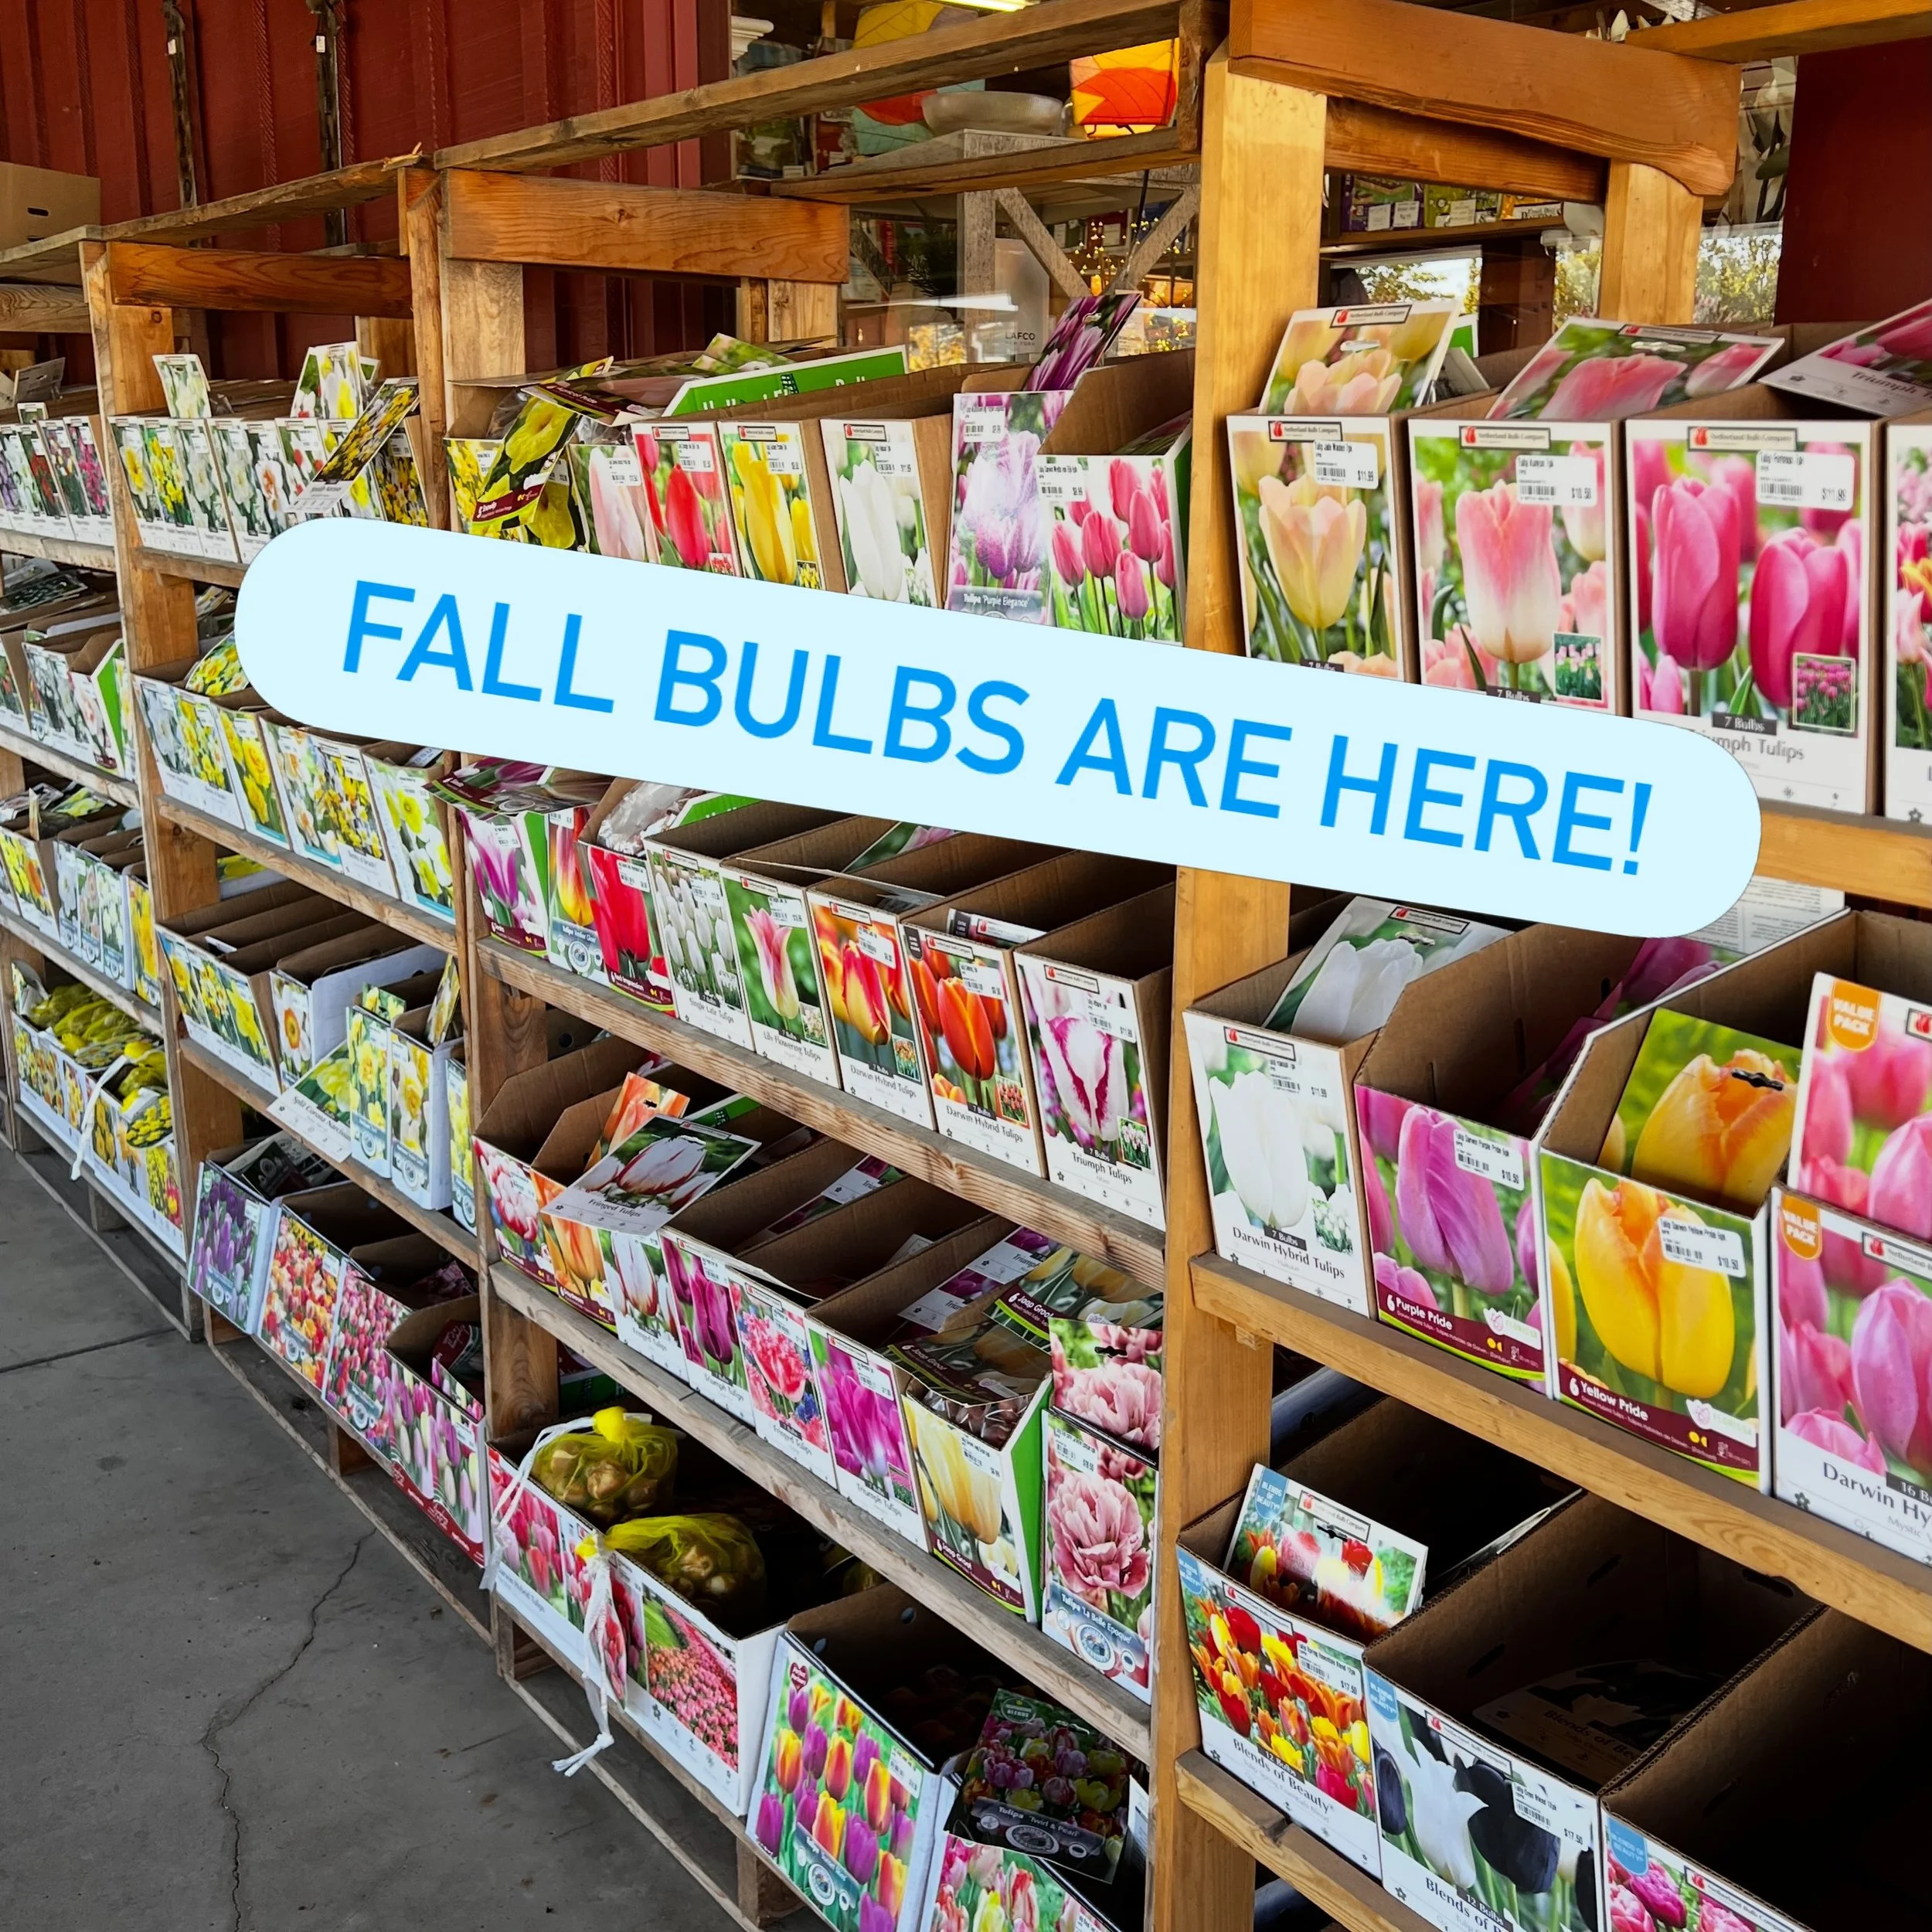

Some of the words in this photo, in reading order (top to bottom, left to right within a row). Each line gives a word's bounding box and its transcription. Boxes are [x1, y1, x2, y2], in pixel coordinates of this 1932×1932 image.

[1005, 332, 1036, 341] LAFCO
[1852, 371, 1917, 393] Triumph
[963, 593, 981, 605] Tulipa
[1724, 716, 1732, 727] 7
[1734, 718, 1764, 732] Bulbs
[1758, 736, 1805, 761] Tulips
[718, 1006, 734, 1025] Tulips
[1833, 998, 1876, 1018] VALUE
[1834, 1013, 1870, 1036] PACK
[774, 1034, 803, 1054] Flowering
[803, 1046, 821, 1062] Tulips
[850, 1063, 873, 1080] Darwin
[875, 1073, 896, 1090] Hybrid
[897, 1081, 917, 1098] Tulips
[292, 1095, 304, 1111] Split
[305, 1103, 325, 1121] Corona
[946, 1106, 973, 1124] Darwin
[975, 1114, 1000, 1134] Hybrid
[1002, 1124, 1023, 1143] Tulips
[1094, 1148, 1111, 1162] Bulbs
[1072, 1151, 1106, 1174] Triumph
[1107, 1162, 1133, 1185] Tulips
[1502, 1168, 1519, 1185] $10.50
[588, 1199, 619, 1213] Fringed
[619, 1205, 641, 1218] Tulips
[1783, 1209, 1818, 1233] VALUE
[1279, 1232, 1299, 1247] Bulbs
[1786, 1224, 1817, 1247] PACK
[1232, 1226, 1271, 1250] Darwin
[1272, 1239, 1310, 1264] Hybrid
[1313, 1253, 1345, 1278] Tulips
[1888, 1247, 1926, 1267] Netherland
[1008, 1292, 1021, 1303] 6
[1387, 1294, 1396, 1312] 6
[1396, 1298, 1427, 1321] Purple
[1427, 1310, 1453, 1331] Pride
[1570, 1377, 1579, 1396] 6
[1580, 1381, 1617, 1406] Yellow
[1618, 1401, 1648, 1421] Pride
[1261, 1481, 1283, 1497] BLENDS
[1266, 1492, 1275, 1501] OF
[1823, 1461, 1894, 1512] Darwin
[1901, 1481, 1916, 1496] 16
[1345, 1518, 1367, 1533] Company
[1888, 1515, 1921, 1539] Mystic
[1061, 1594, 1080, 1612] Tulipa
[1091, 1612, 1107, 1628] Belle
[1341, 1679, 1357, 1696] $17.50
[1543, 1709, 1590, 1736] Blends
[1233, 1738, 1271, 1773] Blends
[1274, 1768, 1286, 1783] of
[1265, 1751, 1274, 1761] 12
[1275, 1758, 1298, 1777] Bulbs
[998, 1806, 1024, 1820] Tulipa
[1563, 1828, 1583, 1845] $17.50
[1426, 1879, 1469, 1917] Blends
[1475, 1912, 1489, 1930] of
[1465, 1894, 1476, 1906] 12
[1479, 1901, 1505, 1926] Bulbs
